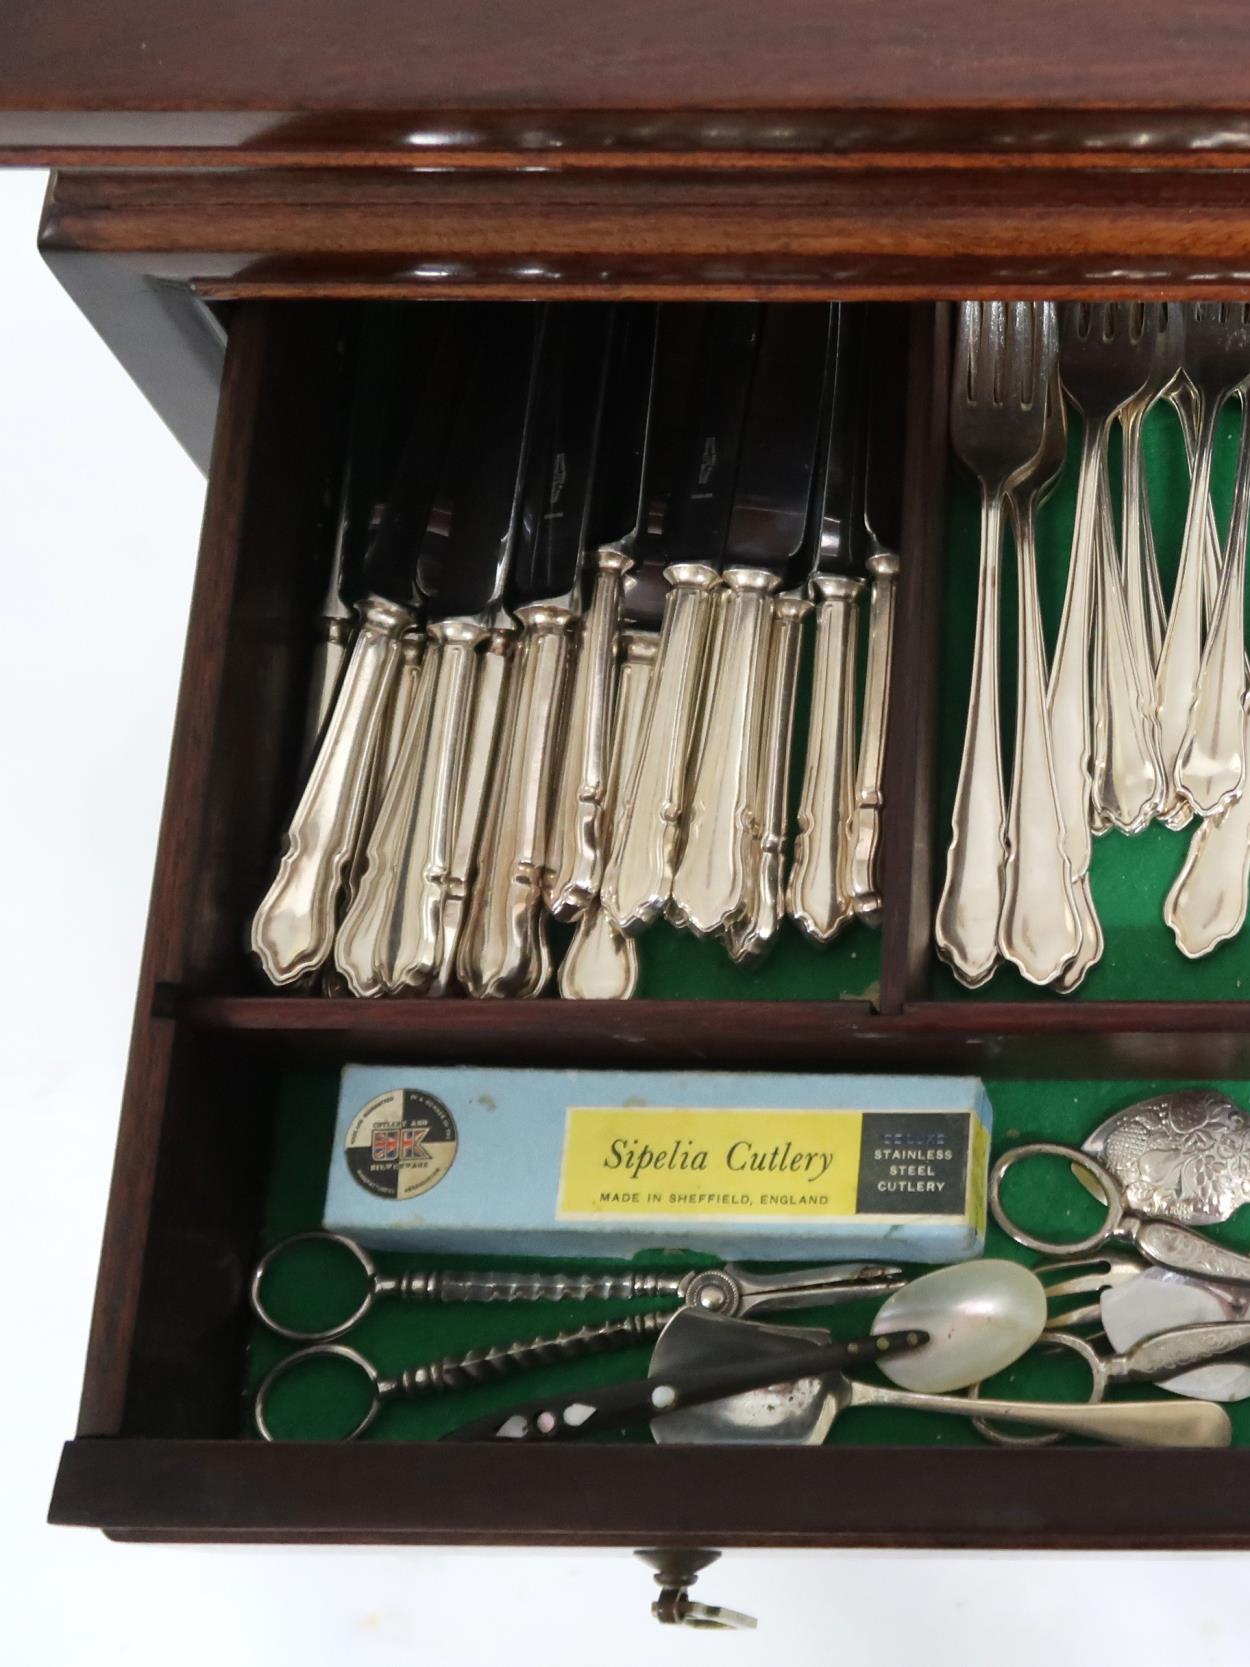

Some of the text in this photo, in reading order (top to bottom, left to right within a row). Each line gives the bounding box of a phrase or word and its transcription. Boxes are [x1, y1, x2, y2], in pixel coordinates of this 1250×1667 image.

[603, 1138, 833, 1182] Sipelia Cutlery
[874, 1149, 953, 1161] STAINLESS
[889, 1165, 935, 1176] STEEL
[877, 1180, 946, 1192] CUTLERY
[600, 1192, 829, 1206] MADE IN SHEFFIELD, ENGLAND
